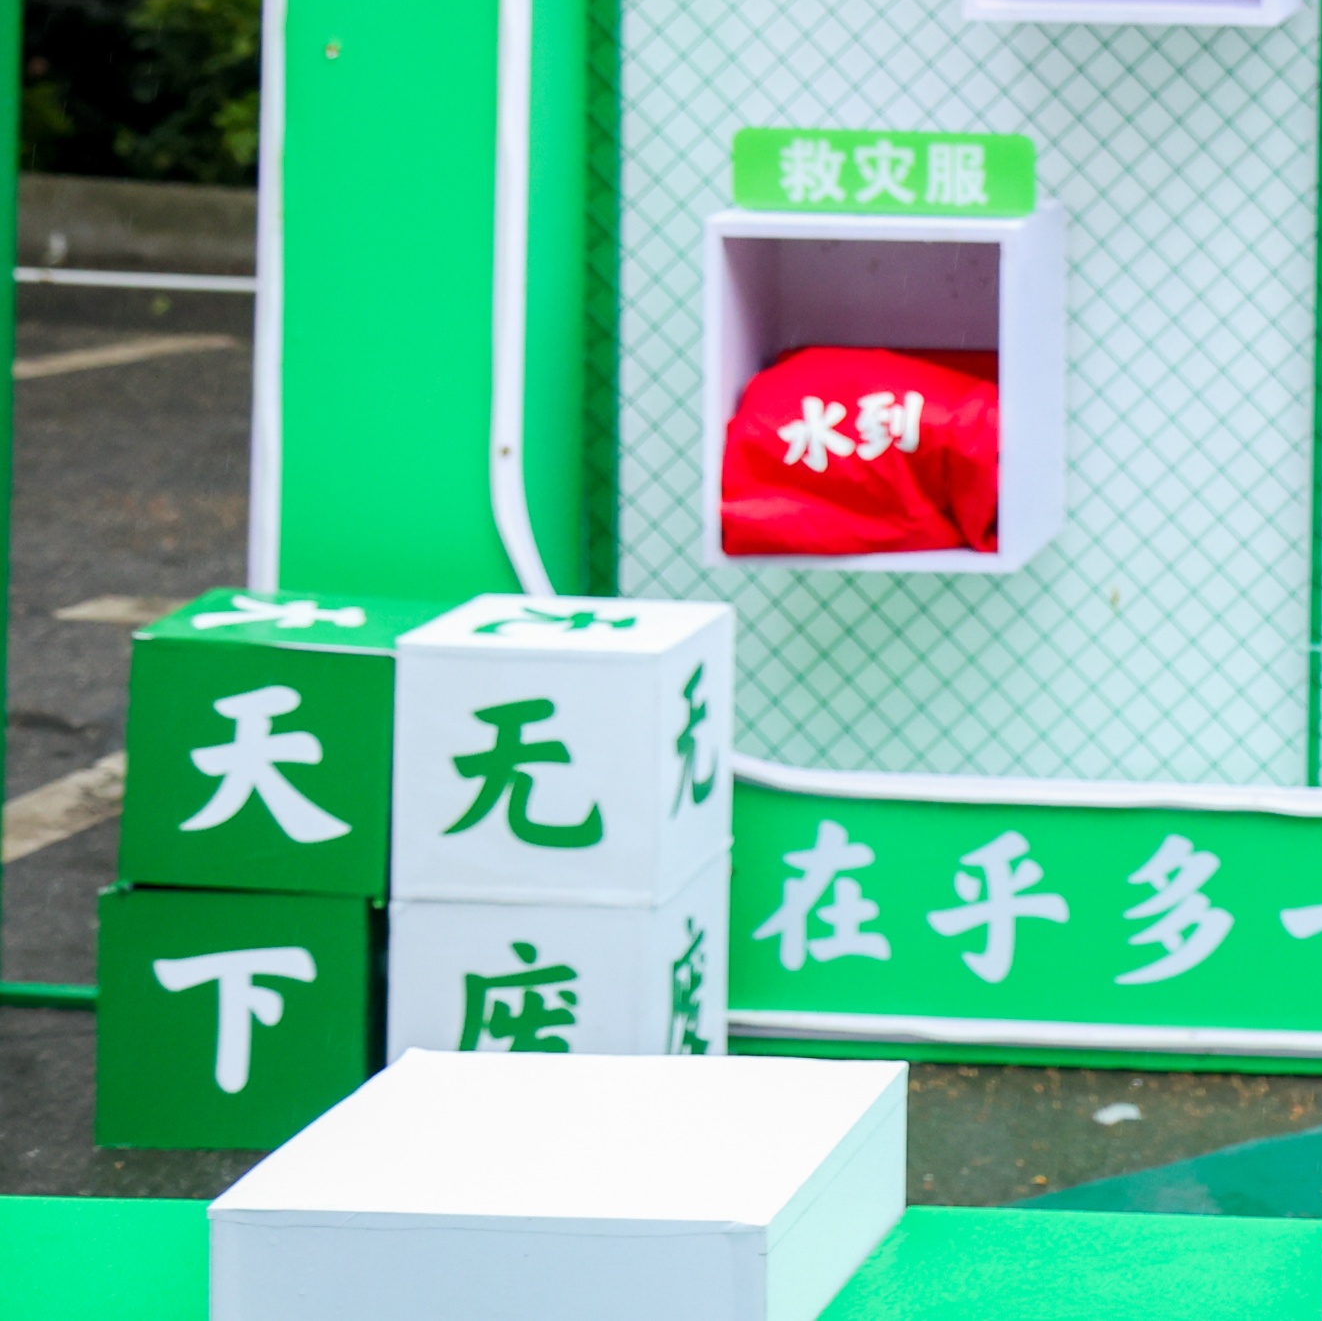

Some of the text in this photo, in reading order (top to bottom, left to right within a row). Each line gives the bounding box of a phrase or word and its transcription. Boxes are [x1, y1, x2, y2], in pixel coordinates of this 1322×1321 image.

[778, 139, 987, 206] 救灾服
[778, 391, 924, 473] 水到
